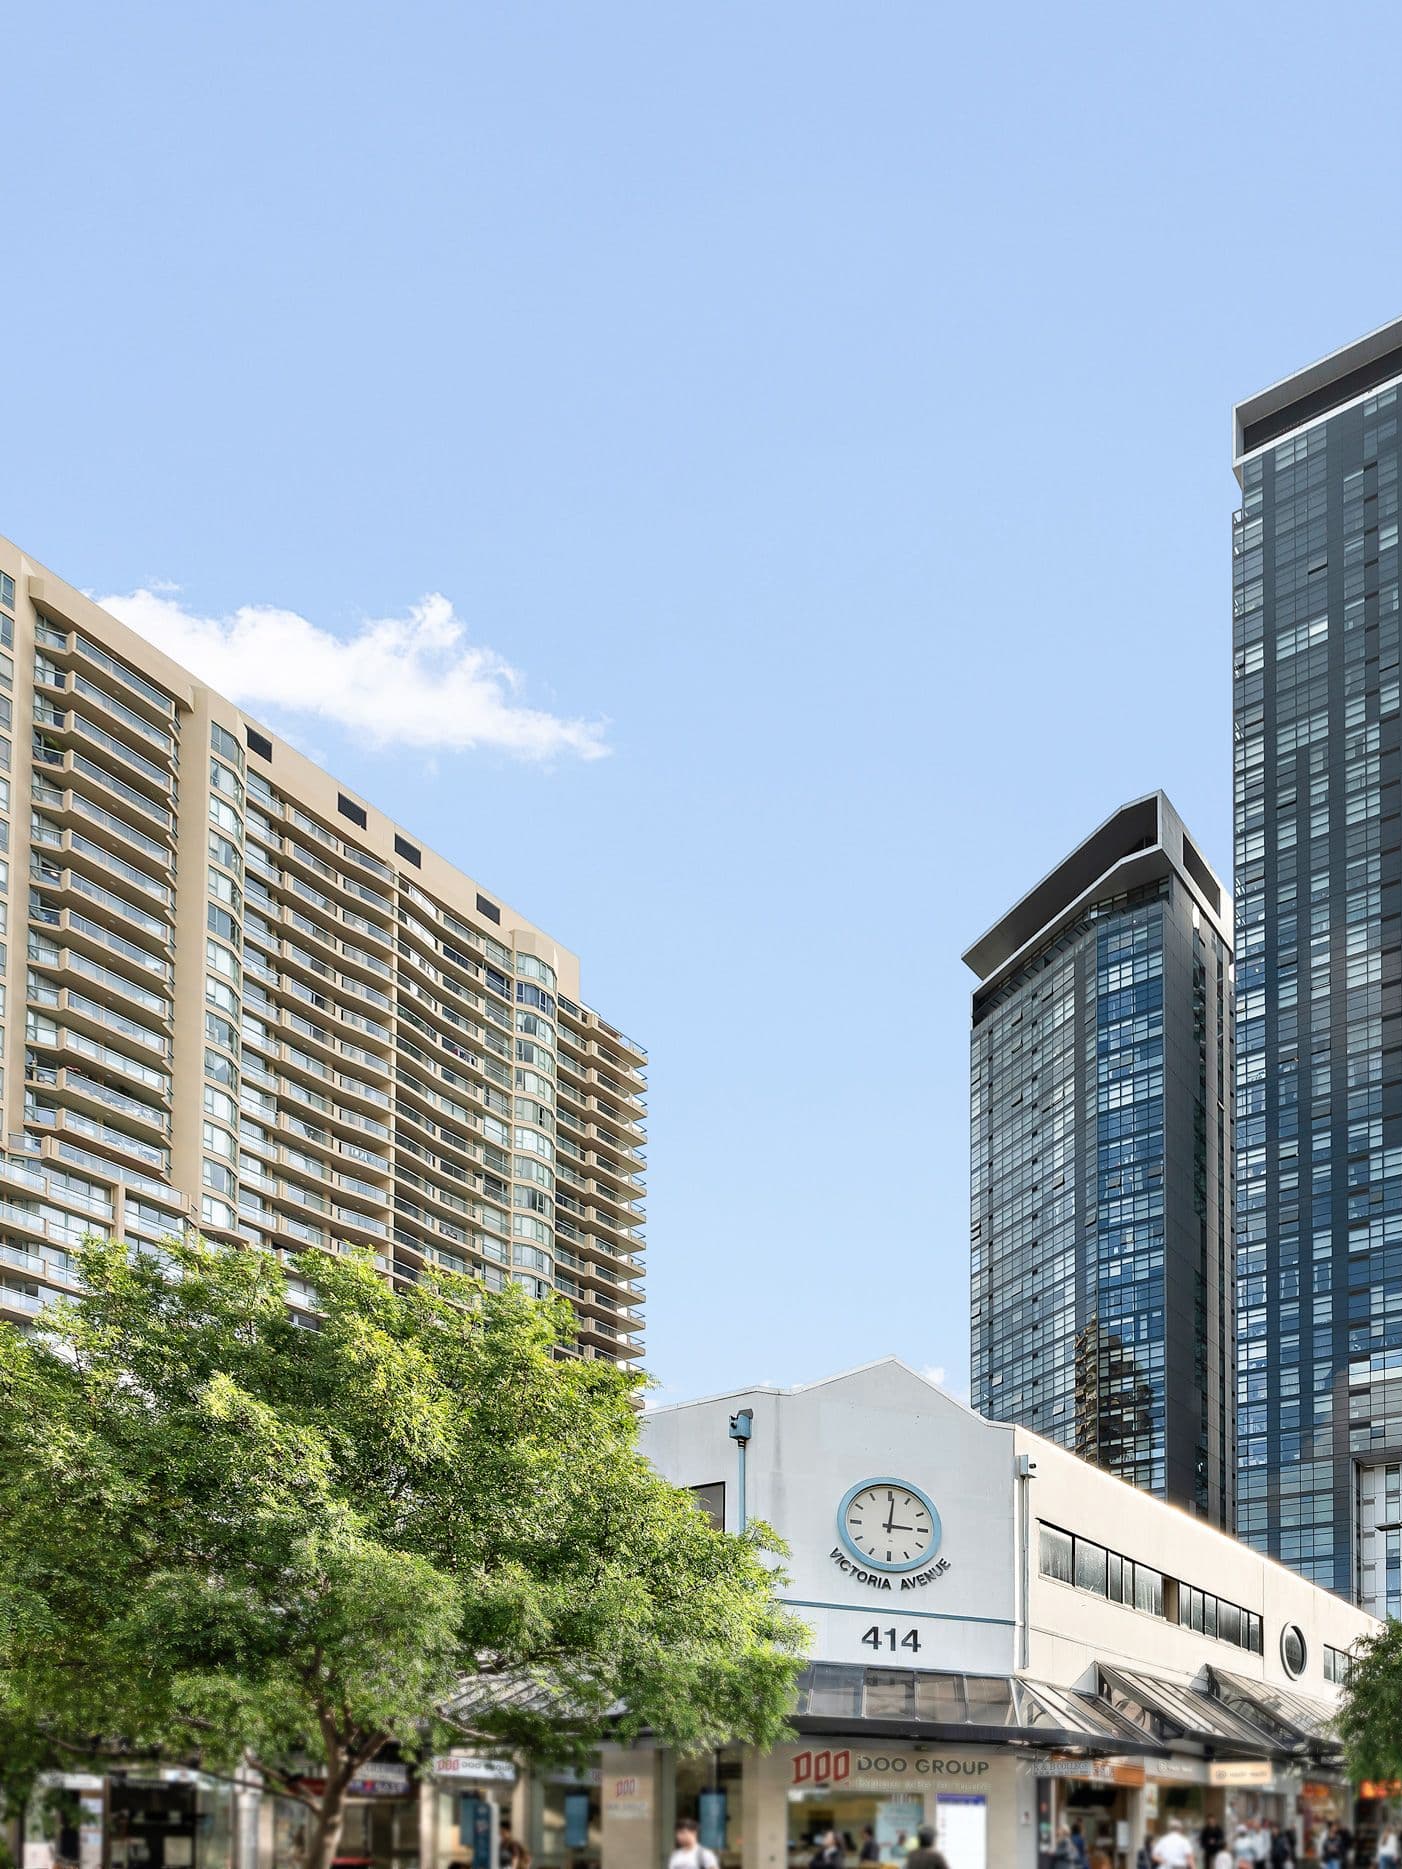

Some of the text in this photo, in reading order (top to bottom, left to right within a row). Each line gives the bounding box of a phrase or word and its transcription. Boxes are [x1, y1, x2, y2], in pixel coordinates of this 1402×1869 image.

[829, 1547, 952, 1591] VICTORIA AVENUE
[861, 1626, 922, 1653] 414
[857, 1756, 907, 1772] DOO
[915, 1758, 989, 1776] GROUP
